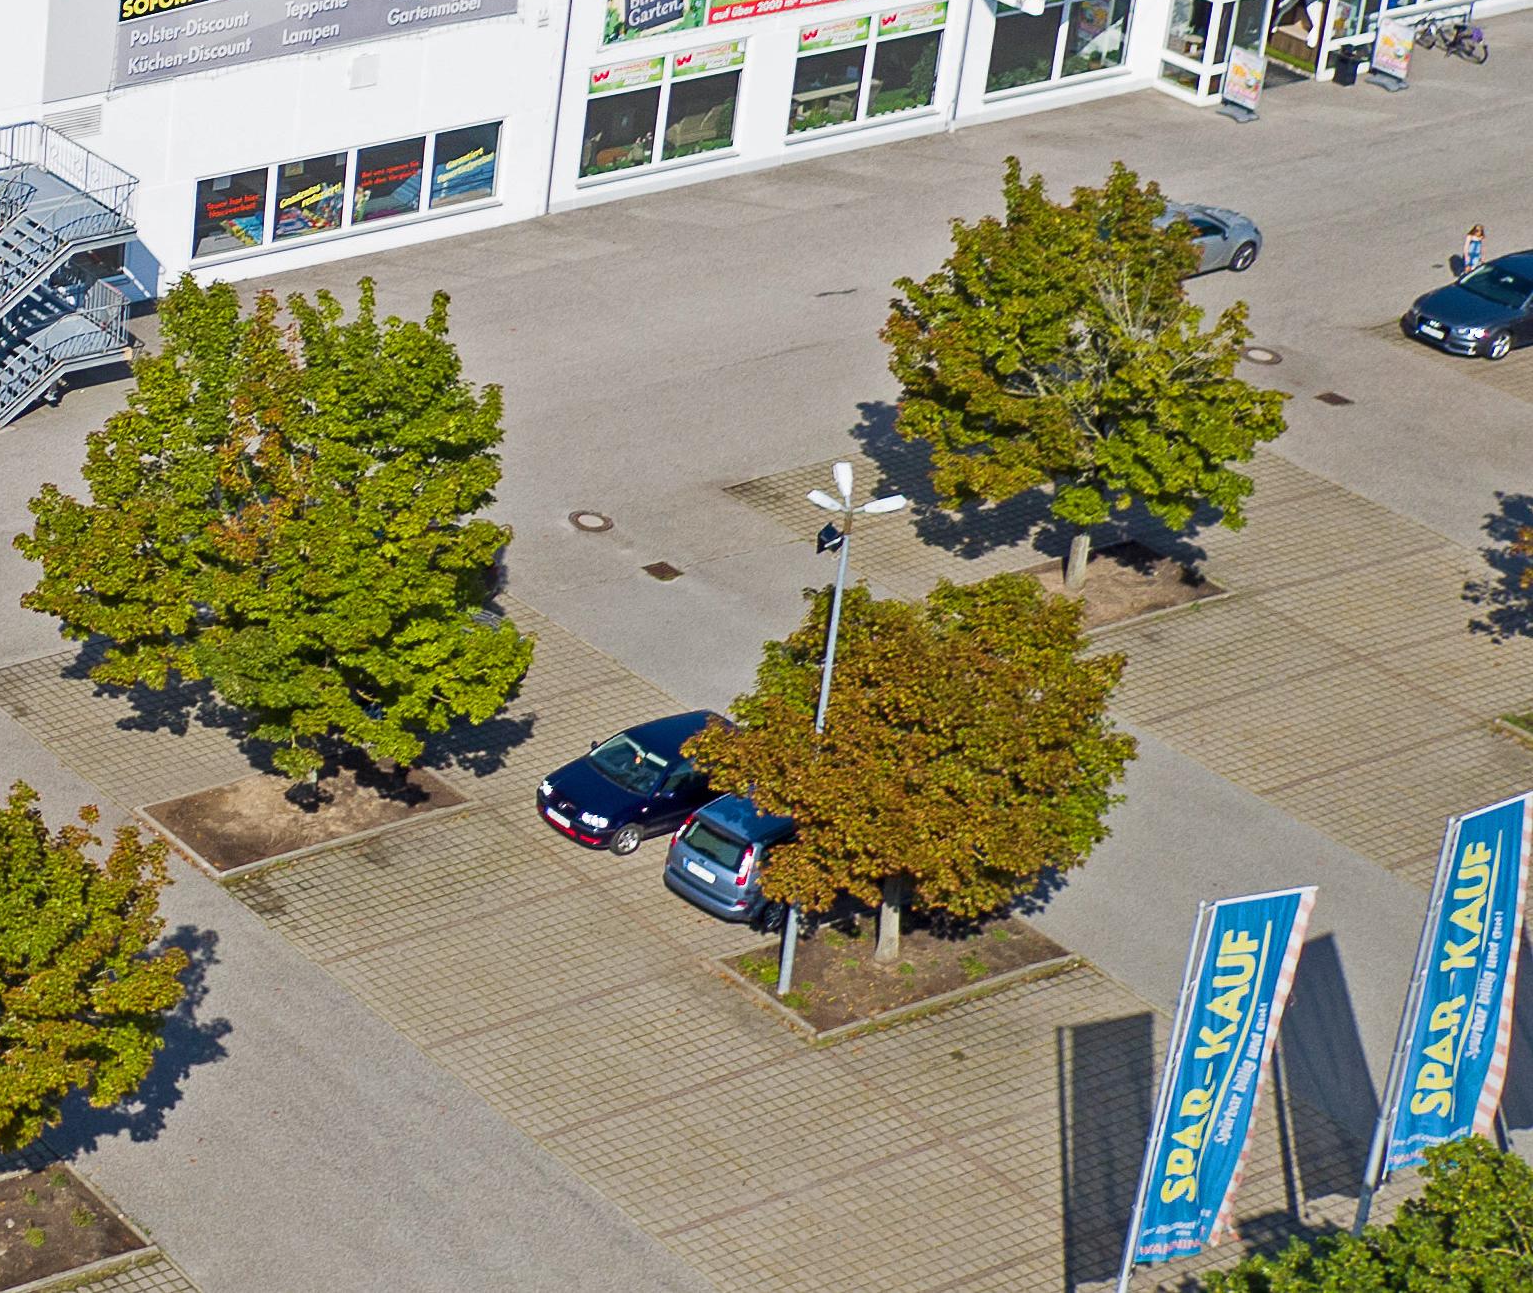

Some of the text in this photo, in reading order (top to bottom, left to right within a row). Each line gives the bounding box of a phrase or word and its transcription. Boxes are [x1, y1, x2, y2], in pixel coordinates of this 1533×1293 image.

[129, 10, 252, 49] Polster-Discount
[281, 21, 341, 46] Lampen
[127, 37, 254, 76] Küchen-Discount
[1408, 839, 1491, 1119] SPAR-KAUF
[1159, 928, 1260, 1205] SPAR-KAUF
